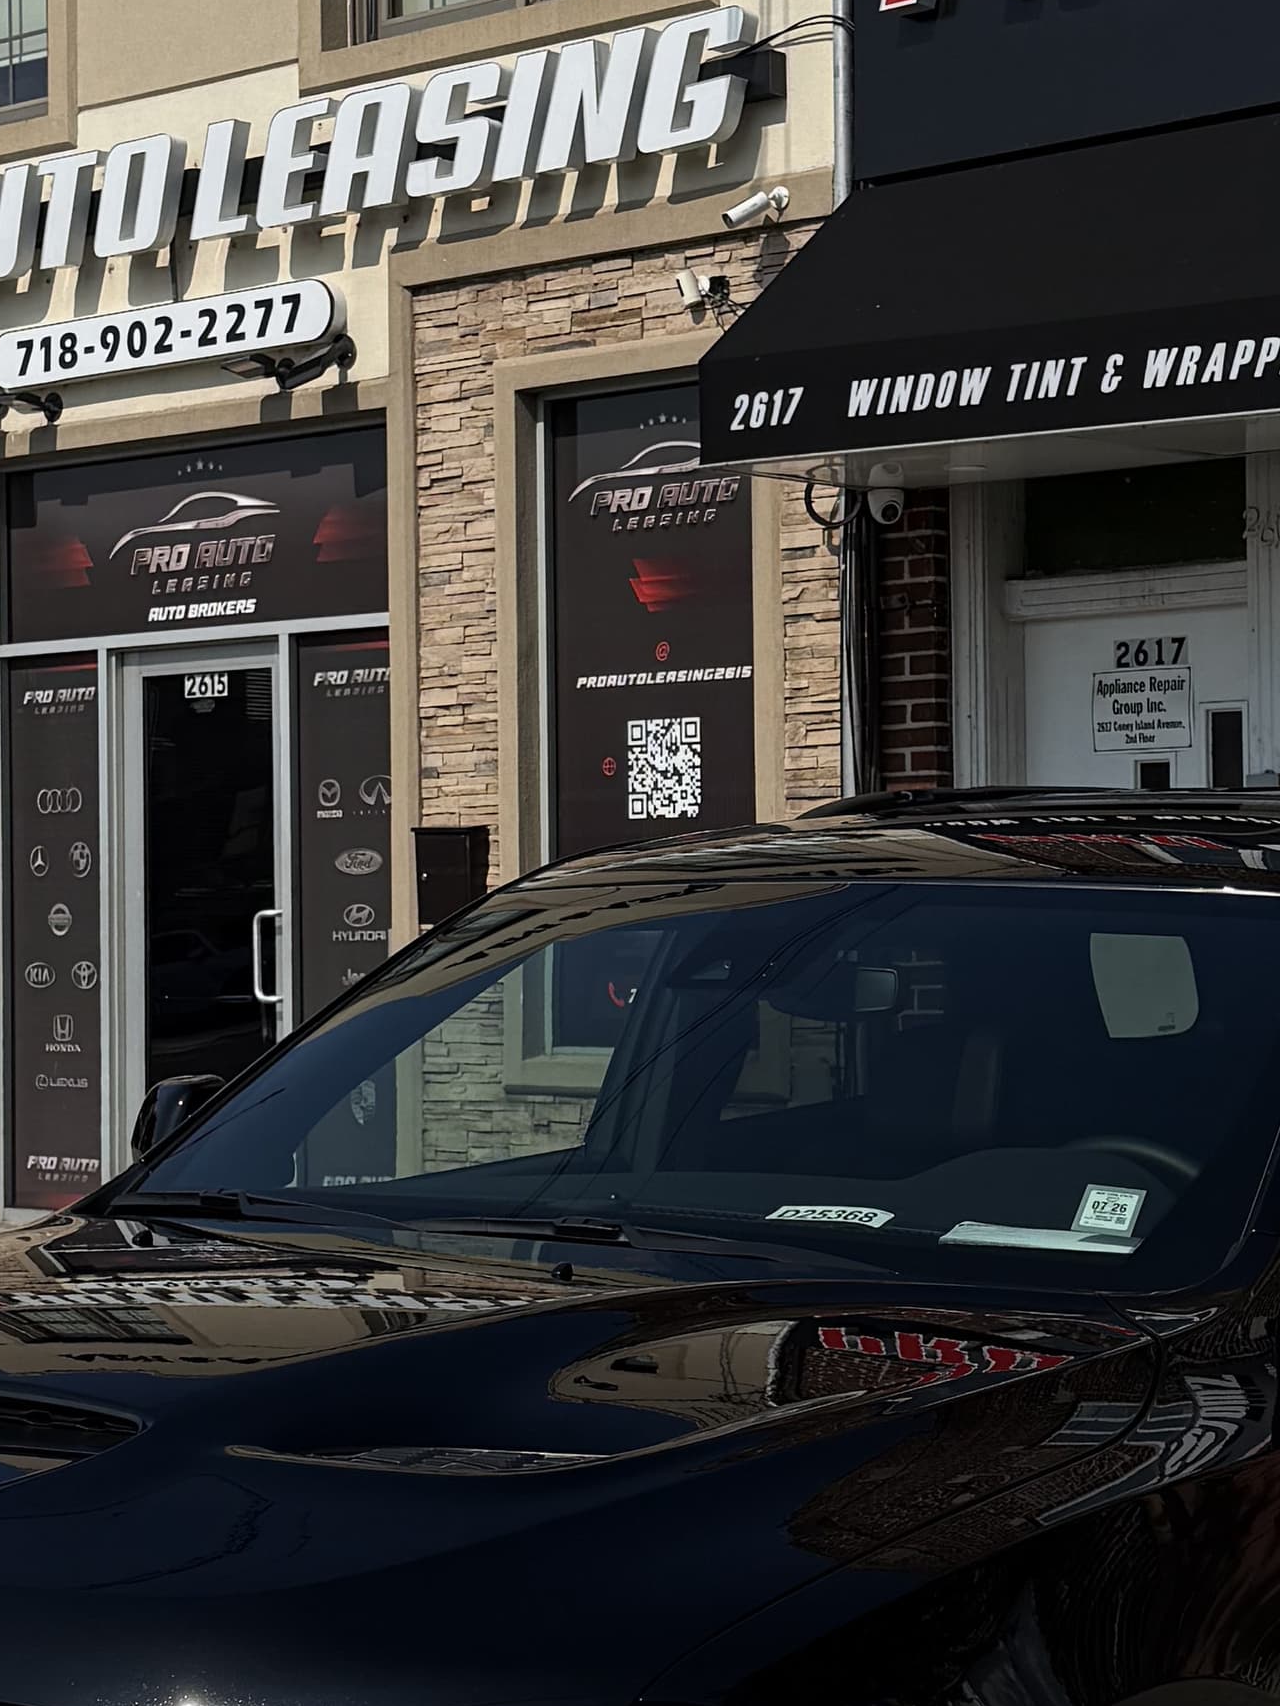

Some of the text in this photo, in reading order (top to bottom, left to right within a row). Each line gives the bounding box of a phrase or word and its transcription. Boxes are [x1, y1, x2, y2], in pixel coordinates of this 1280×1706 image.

[190, 6, 748, 240] LEASING
[16, 293, 301, 376] 718-902-2277
[730, 386, 804, 431] 2617
[847, 366, 991, 417] WINDOW
[1008, 354, 1088, 404] TINT
[1100, 353, 1123, 393] &
[590, 476, 741, 516] PRO AUTO
[612, 508, 716, 532] LEASING
[130, 534, 276, 575] PRO AUTO
[152, 571, 252, 595] LEASING
[148, 599, 257, 621] AUTO BROKERS
[1116, 637, 1186, 668] 2617
[186, 672, 226, 696] 2615
[313, 669, 349, 687] PRO
[576, 665, 753, 689] PROAUTOLEASING2615
[1097, 675, 1186, 698] Appliance Repair
[23, 686, 96, 705] PRO AUTO
[1112, 697, 1167, 717] Group Inc.
[1135, 720, 1155, 730] Island
[1125, 733, 1155, 744] 2nd Floor
[332, 930, 386, 941] HYUNDAI
[29, 967, 50, 983] KIA
[45, 1043, 82, 1053] HONDA
[49, 1078, 89, 1088] LEXUS
[27, 1155, 100, 1173] PRO AUTO
[778, 1209, 877, 1223] D25368
[1092, 1200, 1128, 1213] 07 26
